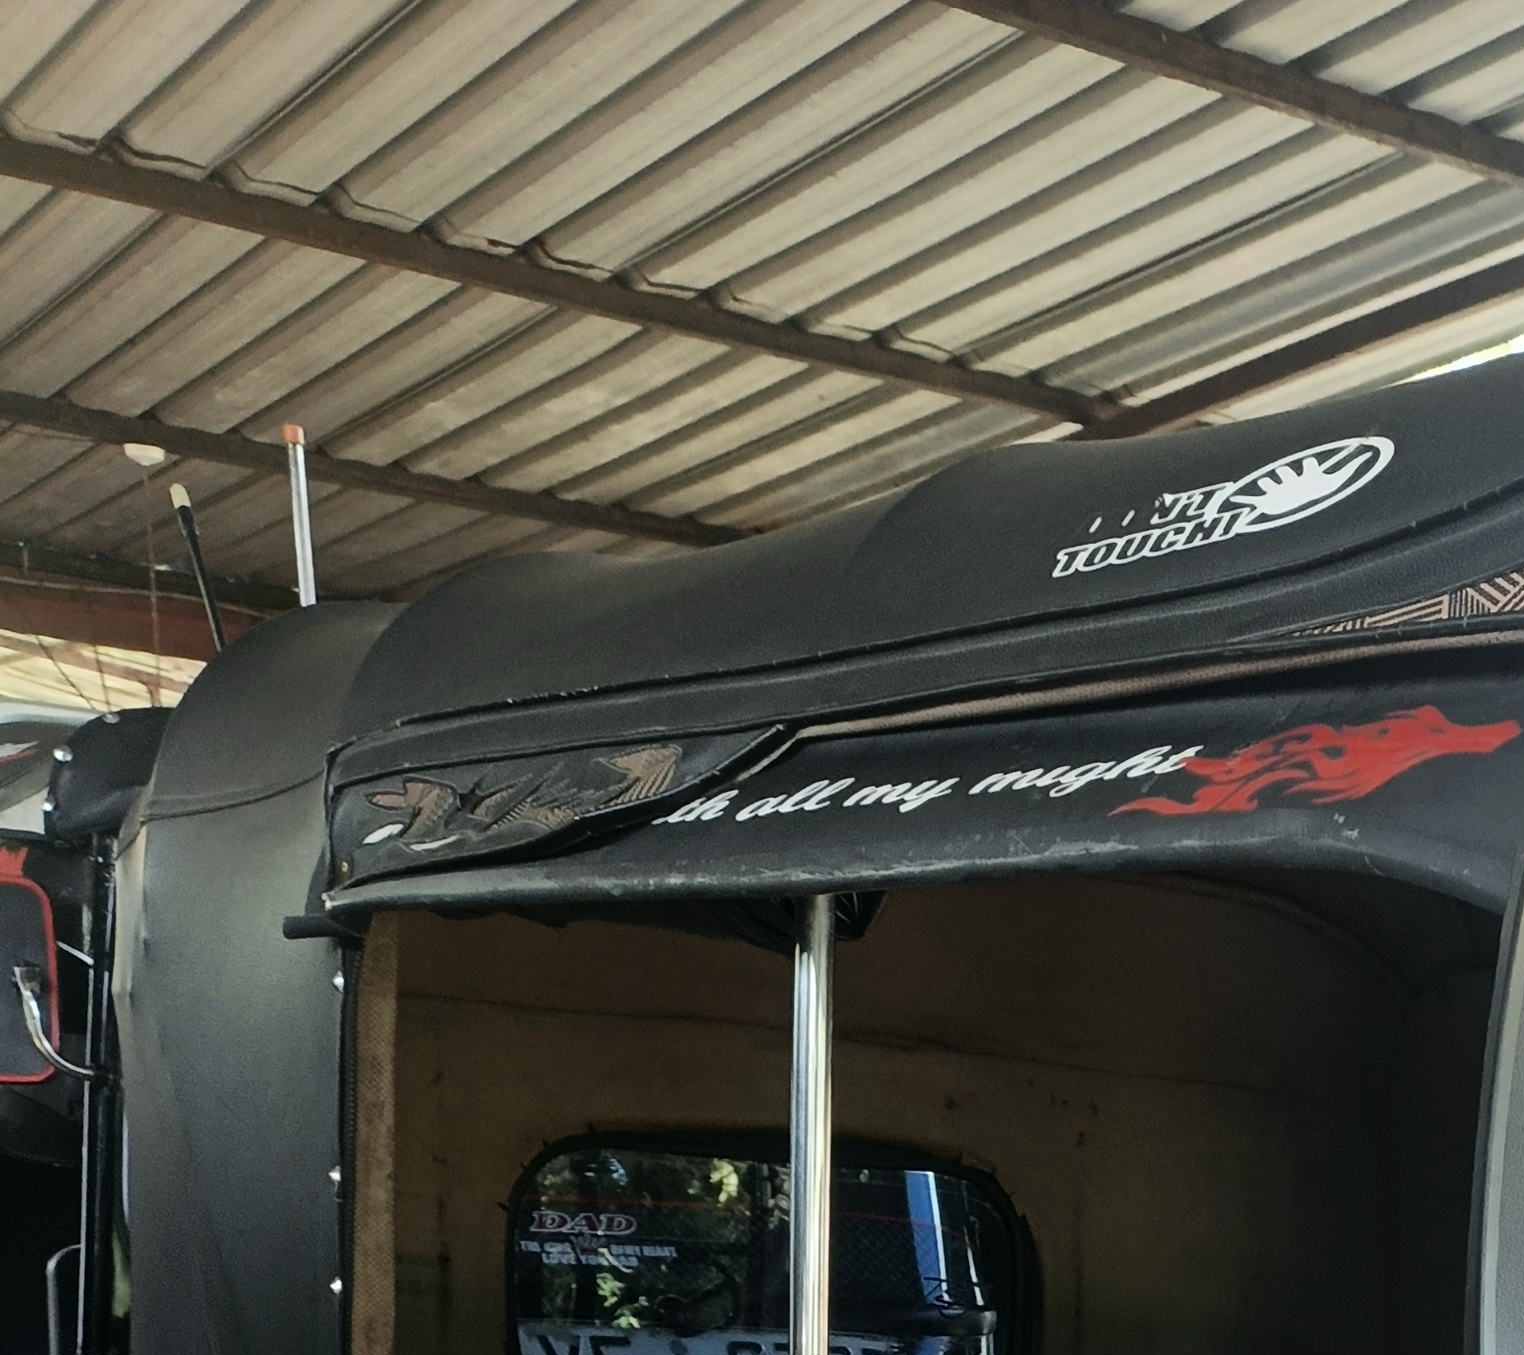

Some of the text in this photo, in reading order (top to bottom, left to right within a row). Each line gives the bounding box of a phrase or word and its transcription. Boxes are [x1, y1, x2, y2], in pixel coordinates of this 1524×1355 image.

[735, 777, 856, 823] all
[843, 777, 960, 813] my
[968, 745, 1204, 798] might
[529, 1209, 638, 1236] DAD
